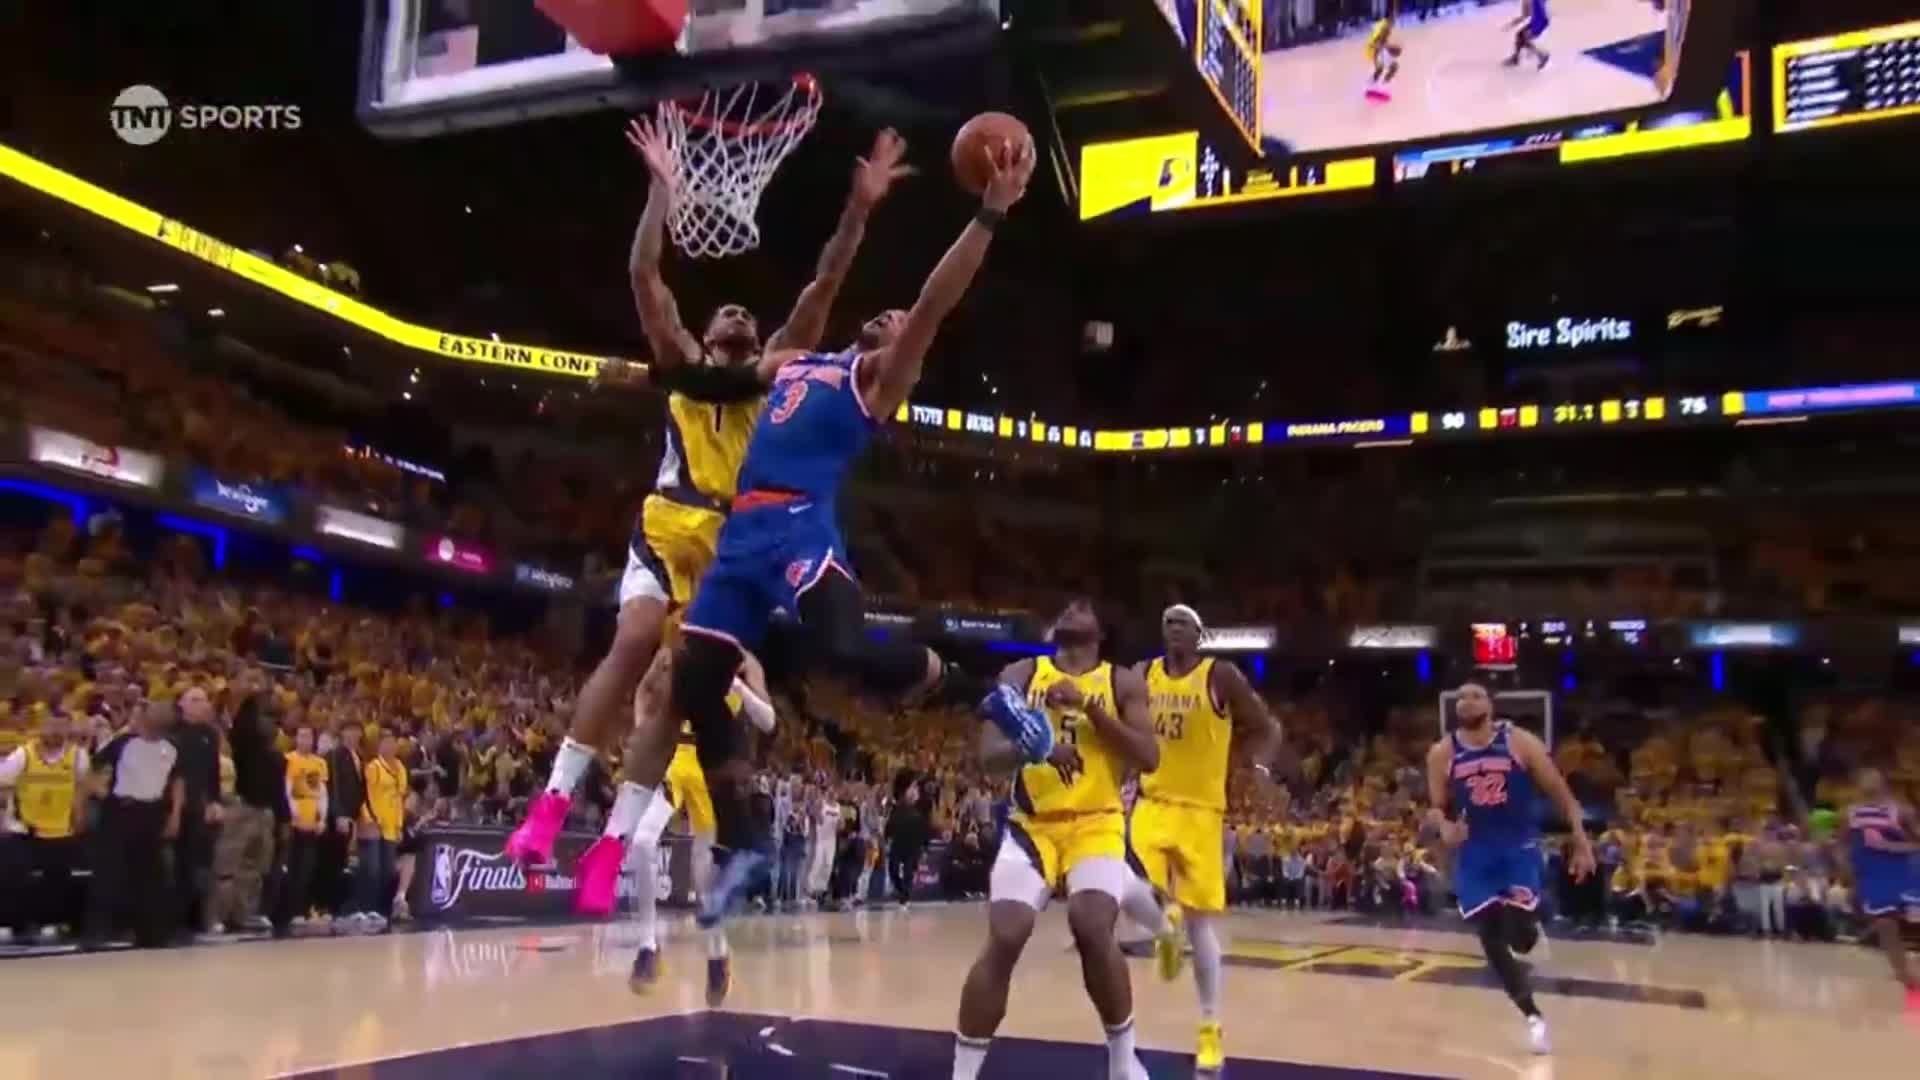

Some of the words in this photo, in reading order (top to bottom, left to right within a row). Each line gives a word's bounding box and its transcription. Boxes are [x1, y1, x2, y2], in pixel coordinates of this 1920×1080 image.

[1506, 321, 1551, 348] Sire
[1556, 317, 1632, 348] Spirits
[438, 335, 532, 364] EASTERN
[540, 352, 600, 376] CONF
[1154, 712, 1184, 740] 43
[438, 848, 527, 909] Finals
